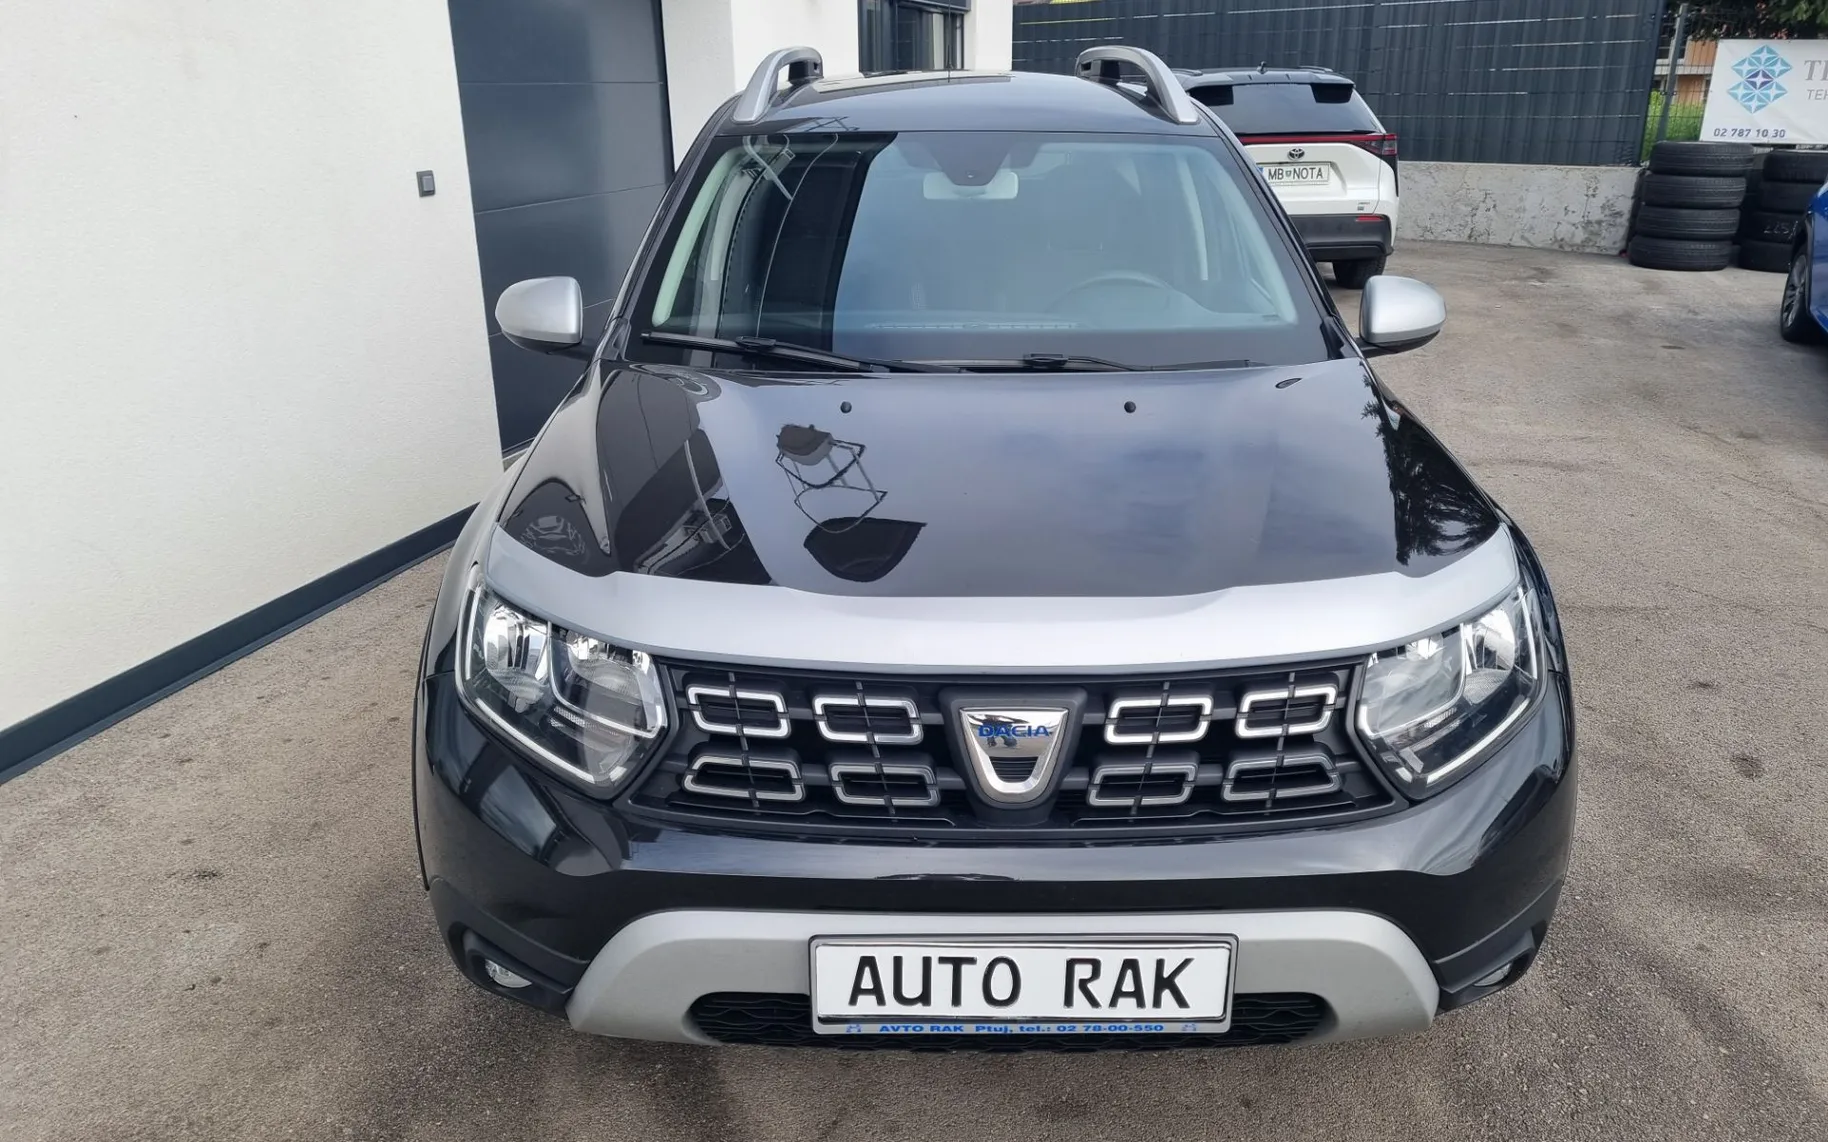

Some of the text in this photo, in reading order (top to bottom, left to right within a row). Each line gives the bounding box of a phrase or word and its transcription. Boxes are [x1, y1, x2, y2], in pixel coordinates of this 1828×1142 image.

[1713, 128, 1786, 138] 02 787 10 30
[1268, 167, 1323, 180] MB NOTA
[979, 725, 1049, 737] DACIA
[848, 955, 1195, 1009] AUTO RAK
[879, 1024, 1164, 1035] AVTO RAK Ptuj, tel.: 02 78-00-550
